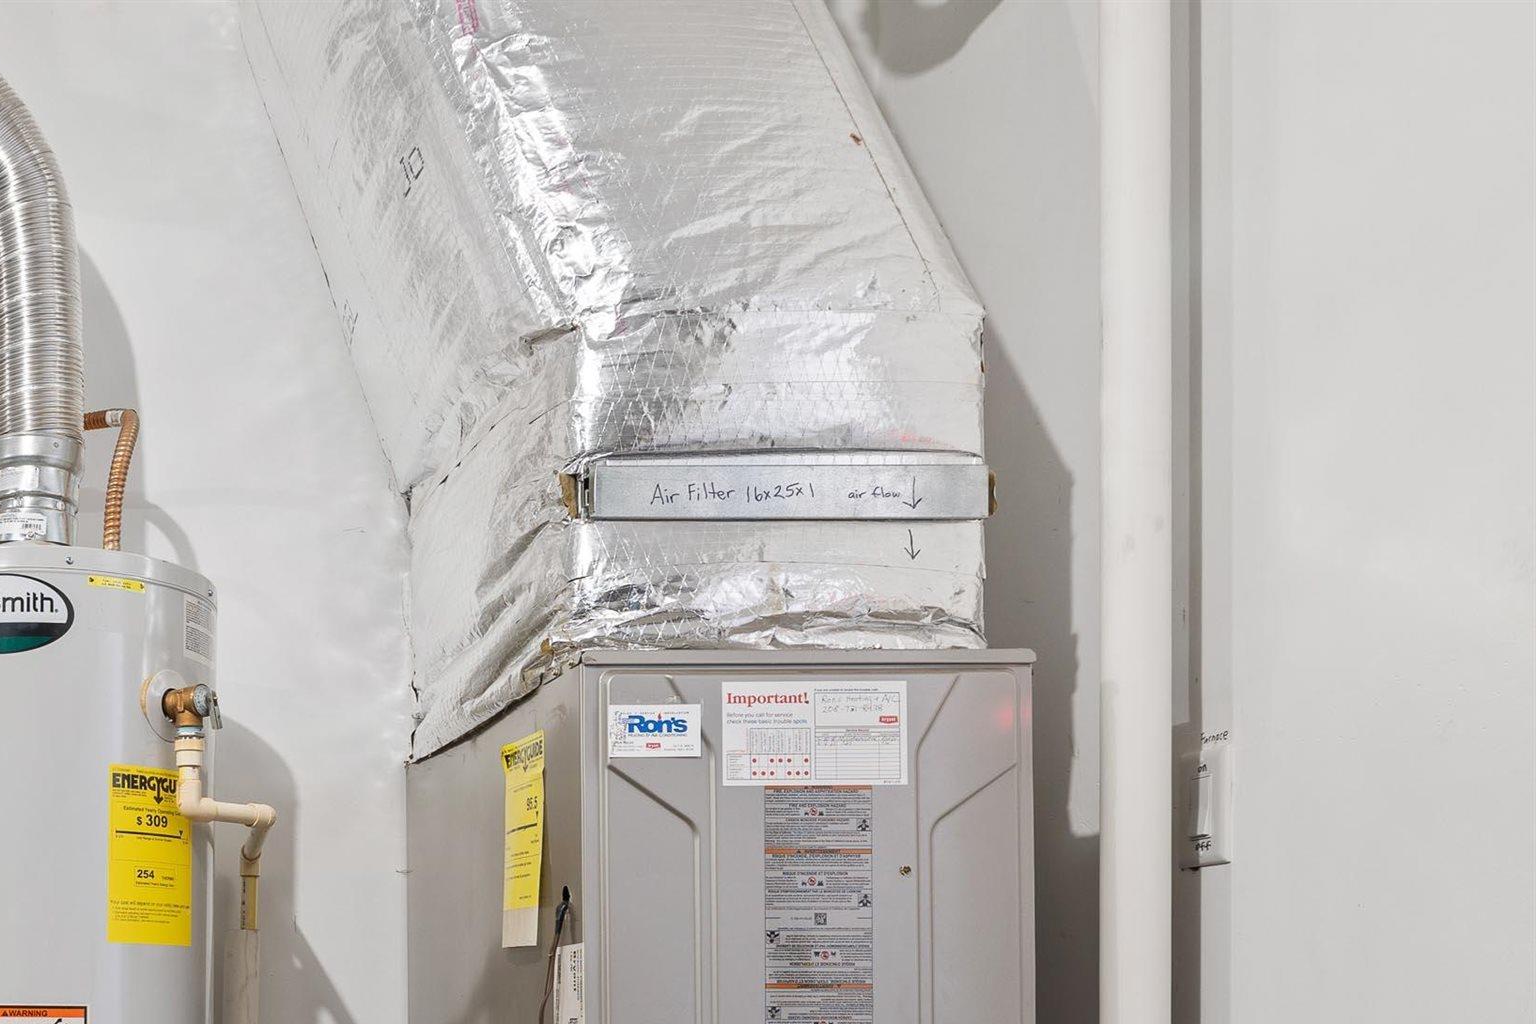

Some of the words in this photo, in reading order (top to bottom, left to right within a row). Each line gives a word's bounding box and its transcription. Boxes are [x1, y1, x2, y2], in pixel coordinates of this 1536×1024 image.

[651, 484, 679, 505] Air
[689, 483, 735, 501] Filter
[746, 483, 815, 503] 16x25x1
[848, 489, 869, 500] air
[872, 487, 901, 500] flow
[726, 692, 810, 707] Important!
[627, 715, 688, 733] Ron's
[112, 772, 178, 794] ENERGYGU
[146, 814, 168, 828] 309
[137, 869, 155, 879] 254
